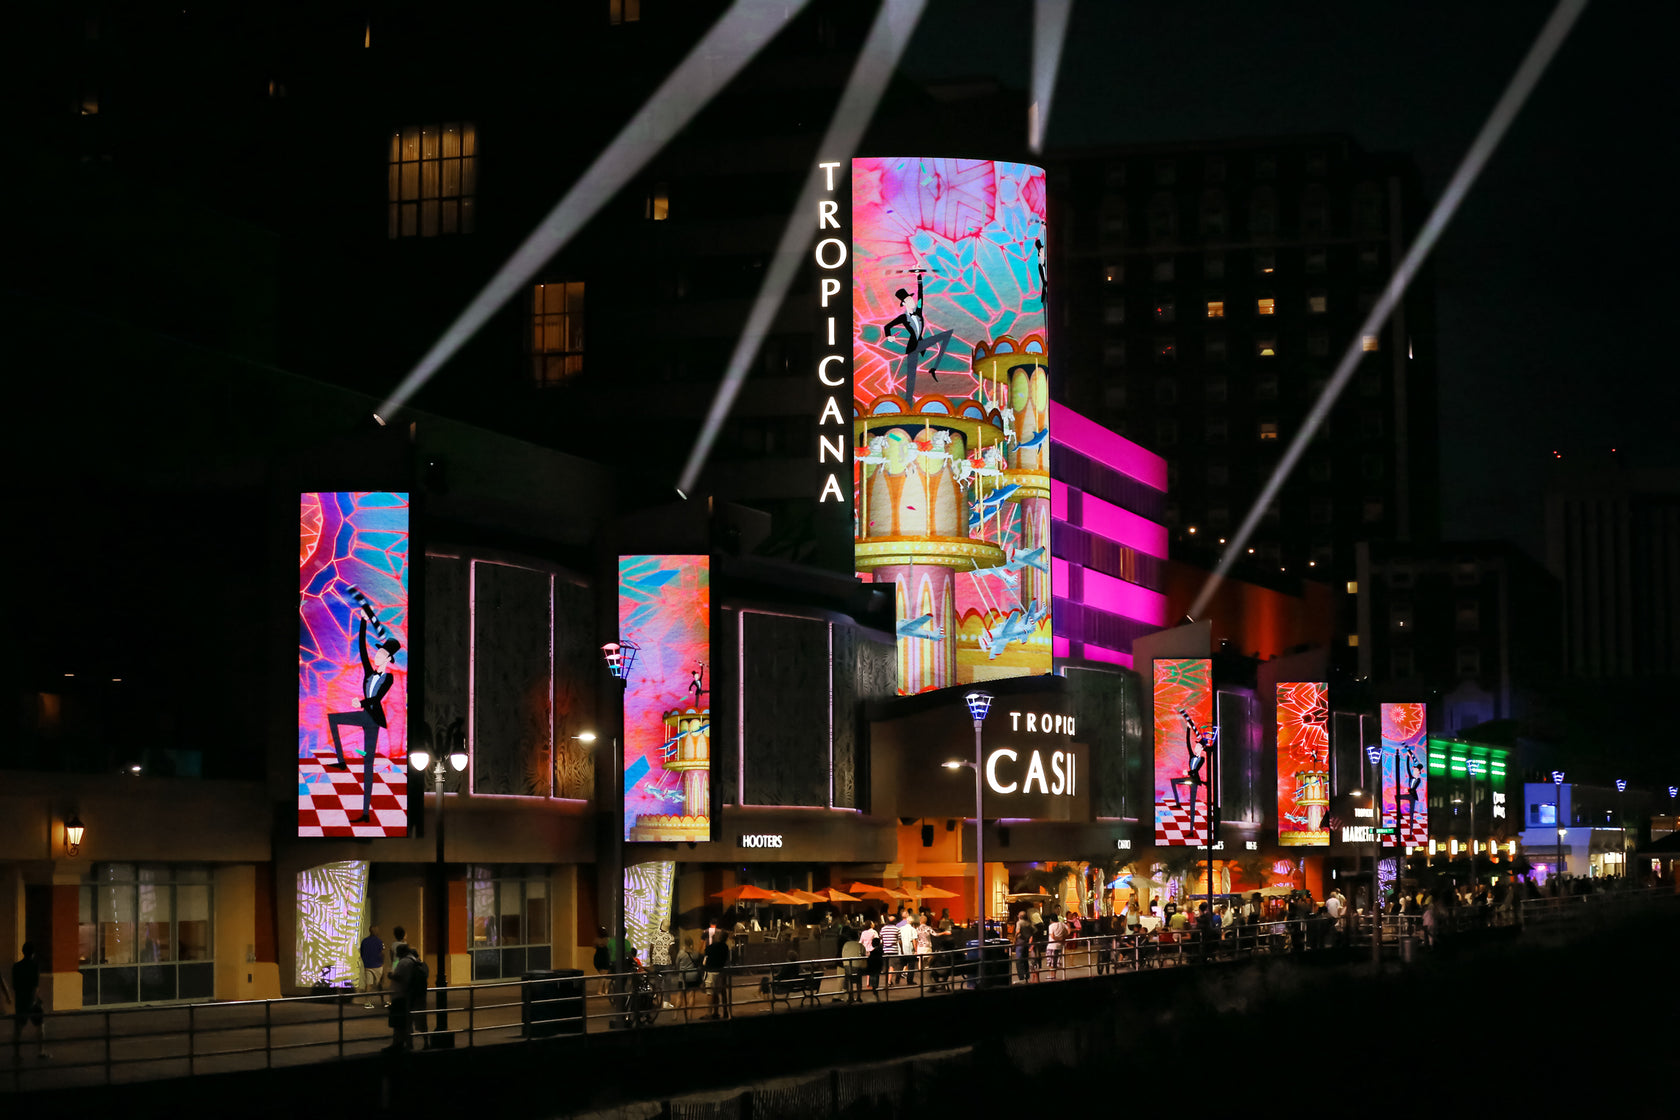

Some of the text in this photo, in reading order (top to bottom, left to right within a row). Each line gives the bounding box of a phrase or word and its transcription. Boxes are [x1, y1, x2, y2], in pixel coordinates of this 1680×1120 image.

[815, 161, 848, 503] TROPICANA
[986, 748, 1076, 797] CASI
[742, 834, 783, 848] HOOTERS
